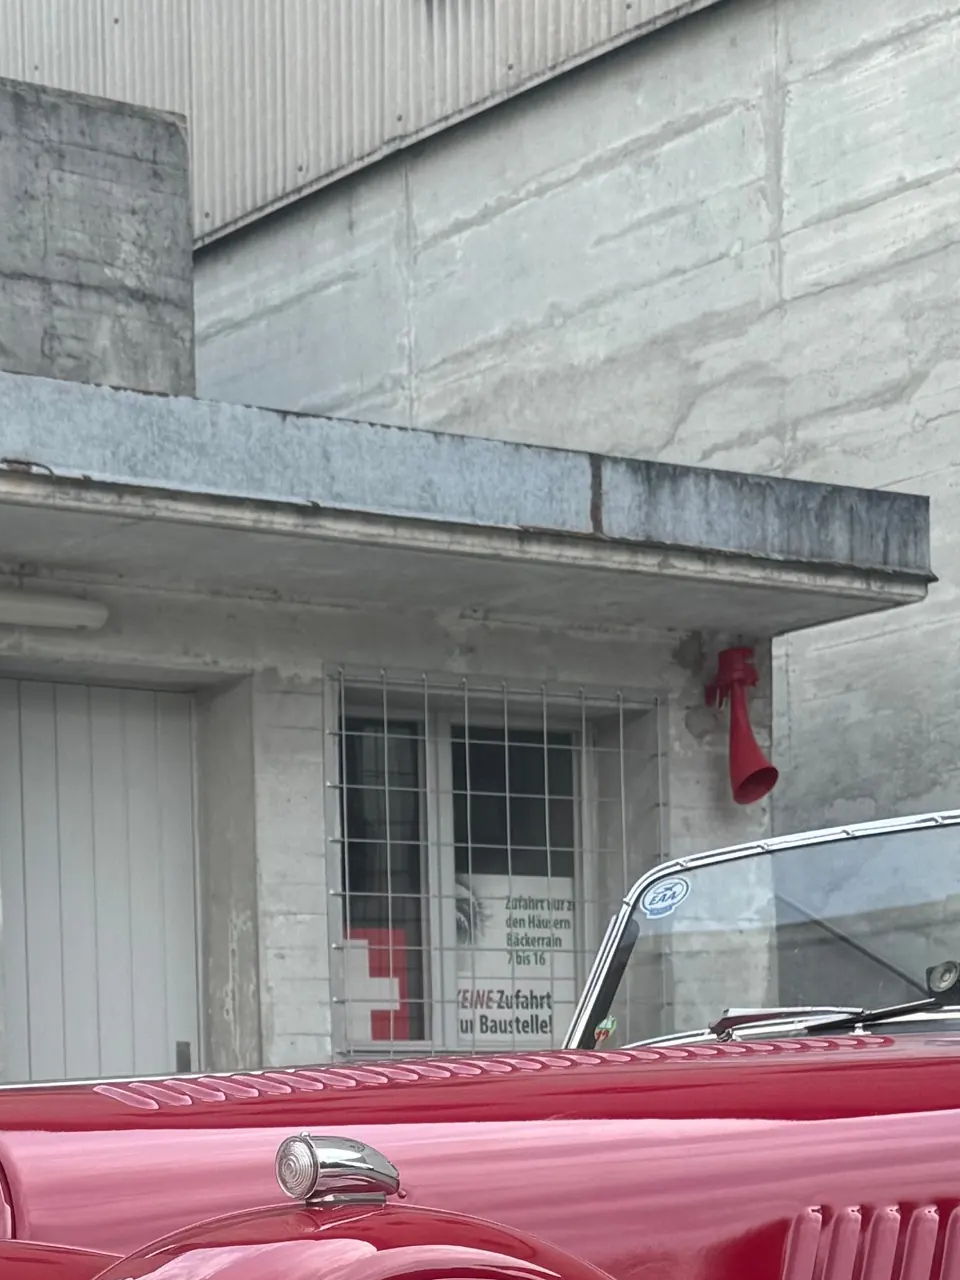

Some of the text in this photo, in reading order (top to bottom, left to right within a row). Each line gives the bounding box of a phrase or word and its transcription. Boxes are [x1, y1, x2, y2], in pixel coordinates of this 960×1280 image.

[505, 895, 544, 911] Zufahrt
[505, 913, 526, 929] den
[506, 931, 563, 948] Bäckerrain
[507, 951, 546, 966] 7 bis 16
[457, 989, 552, 1010] EINE Zufahrt
[480, 1014, 553, 1035] Baustelle!
